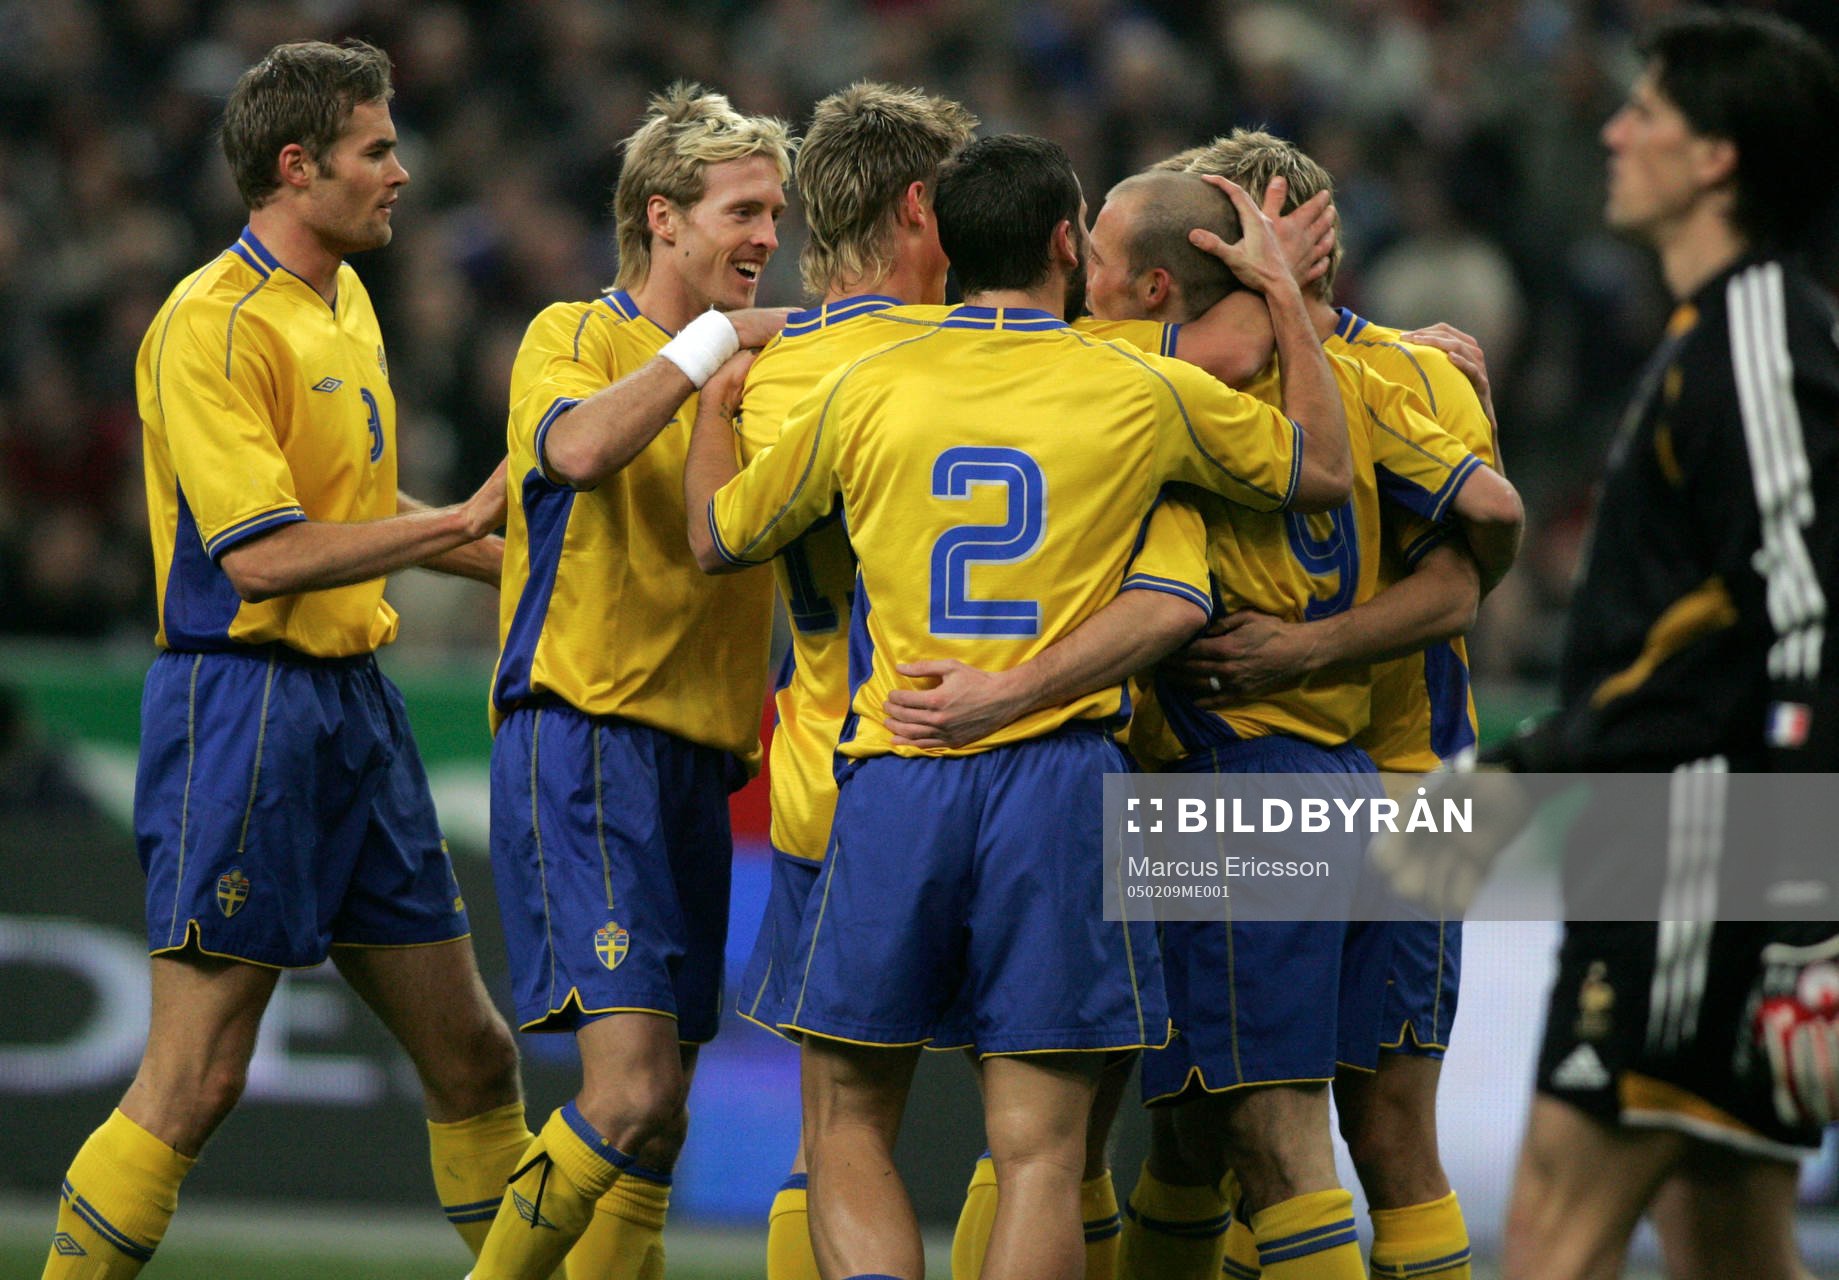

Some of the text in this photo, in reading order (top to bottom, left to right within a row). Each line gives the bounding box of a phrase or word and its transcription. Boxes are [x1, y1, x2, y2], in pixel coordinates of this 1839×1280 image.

[360, 387, 384, 464] 3
[929, 446, 1047, 638] 2
[1284, 500, 1360, 622] 9
